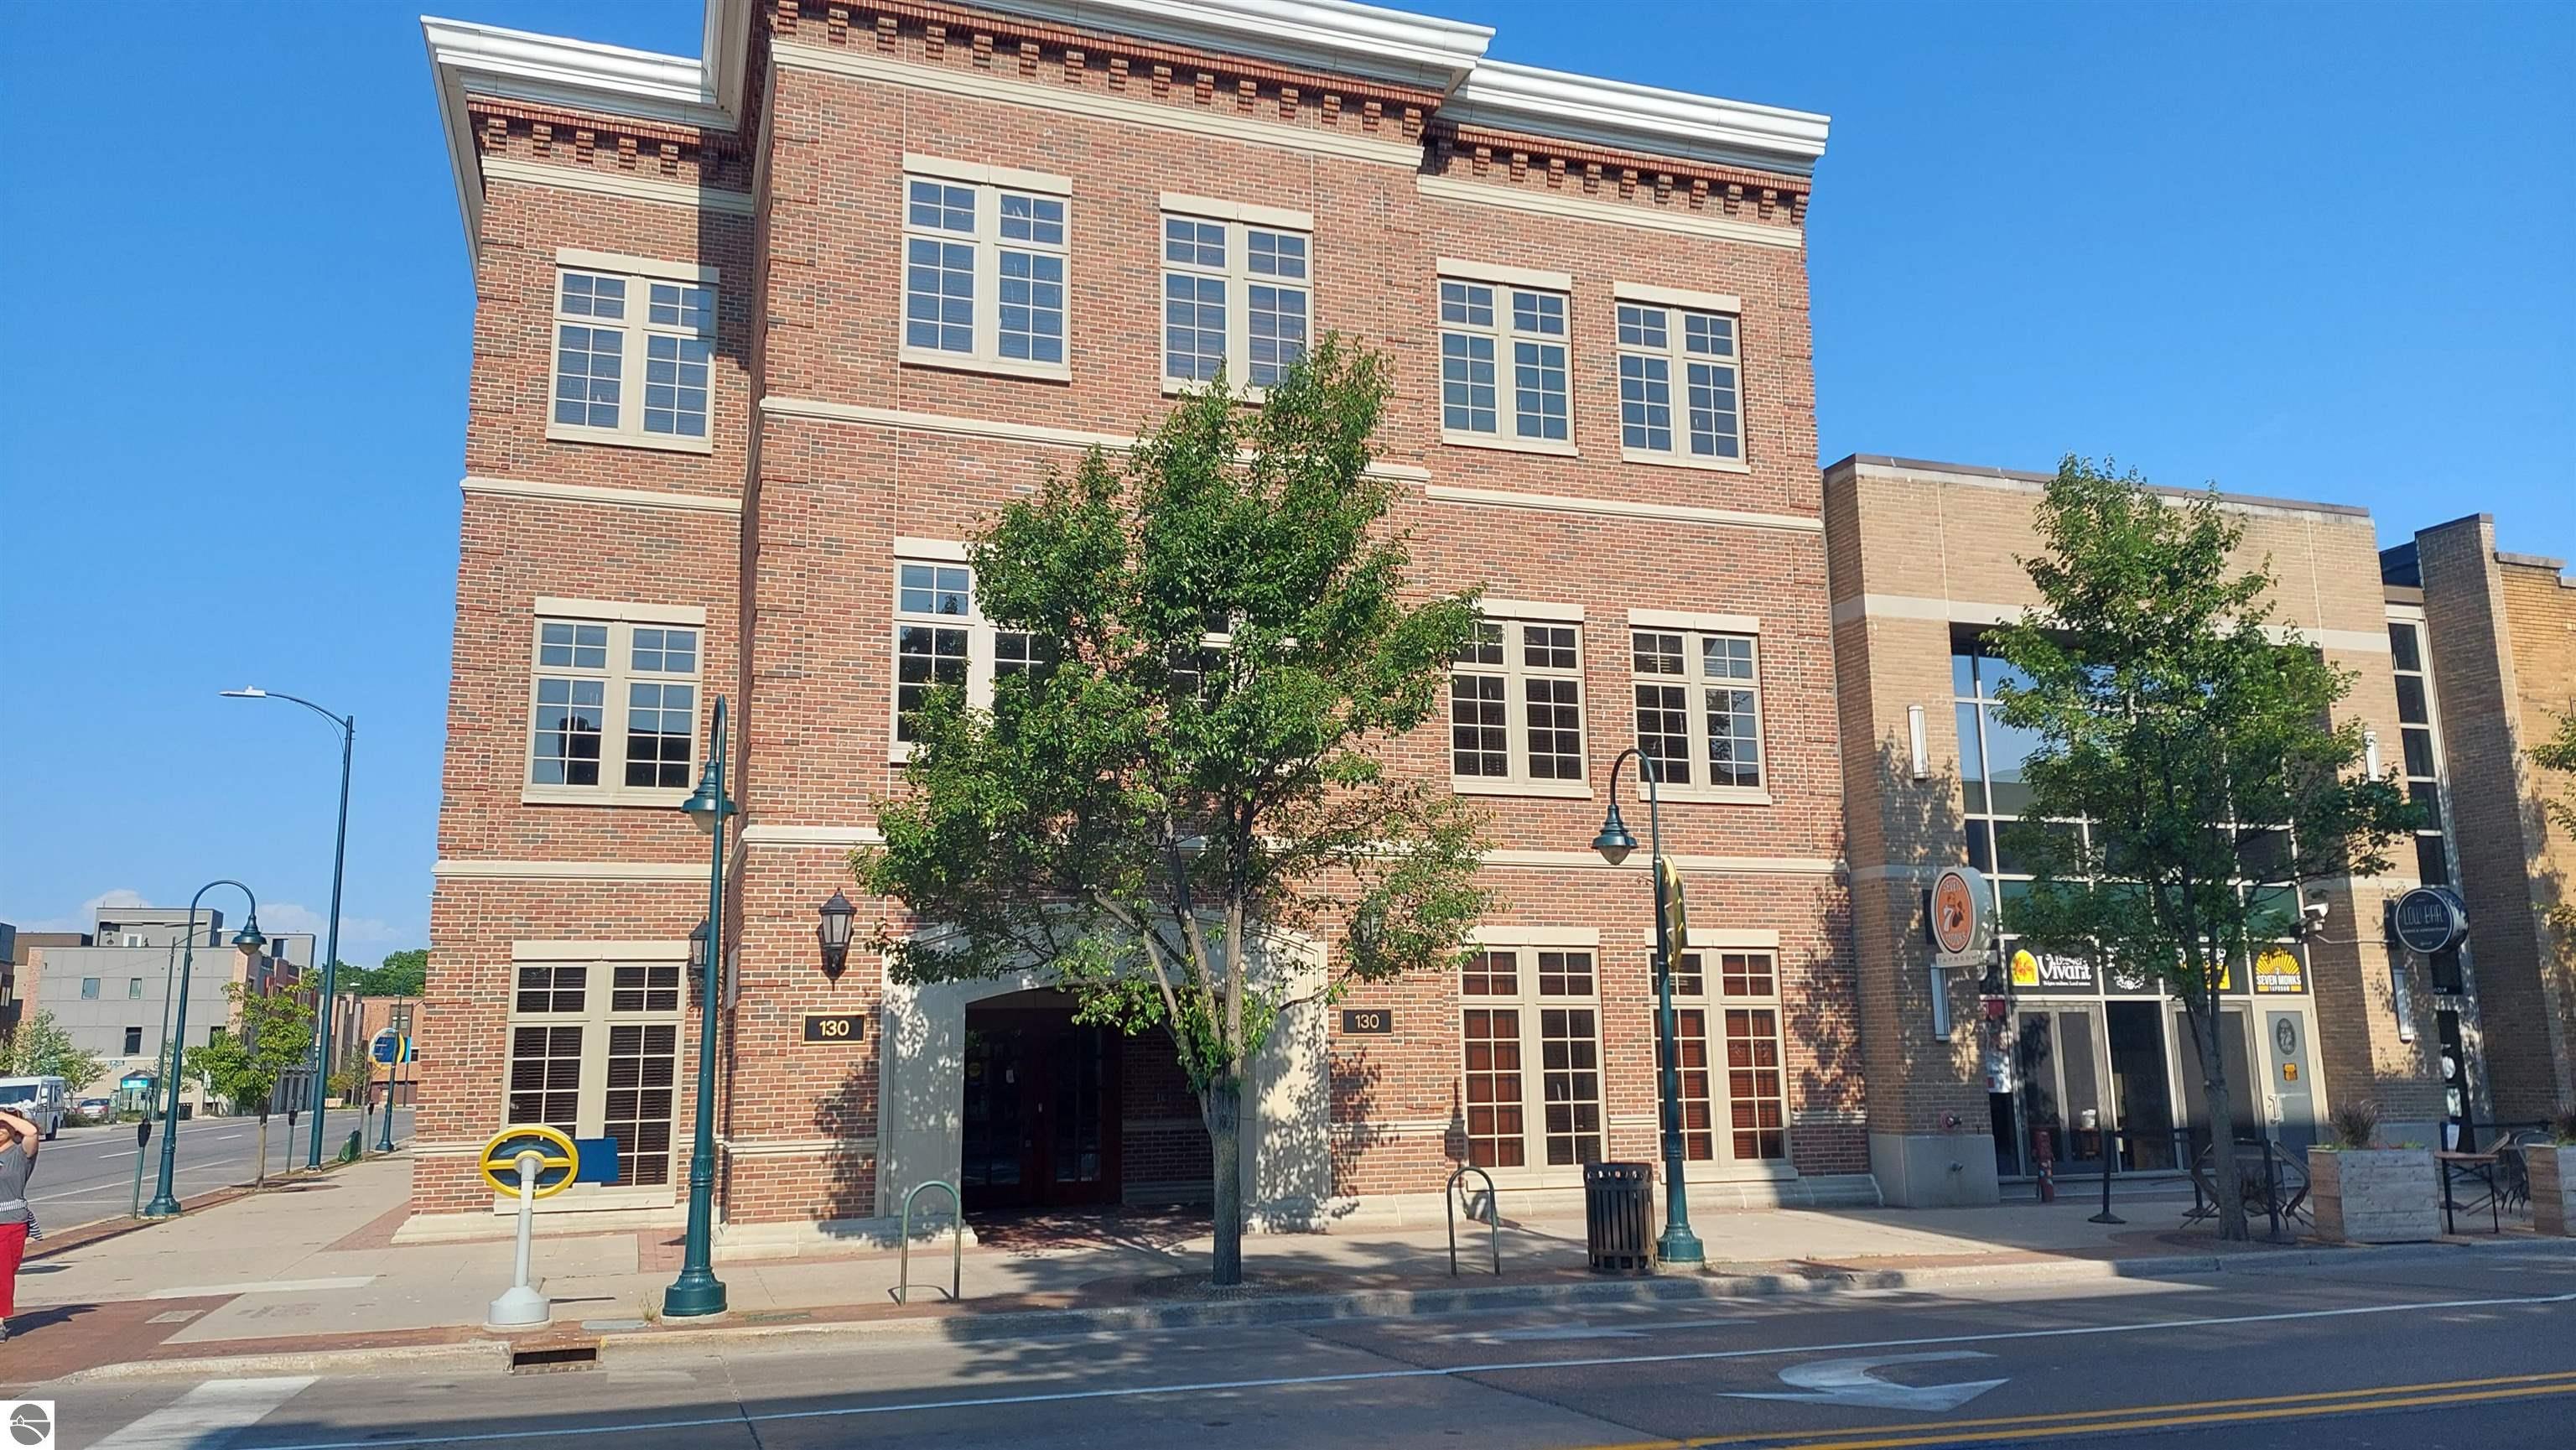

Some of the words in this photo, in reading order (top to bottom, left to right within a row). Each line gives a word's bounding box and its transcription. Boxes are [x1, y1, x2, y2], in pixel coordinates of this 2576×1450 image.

[2402, 906, 2423, 926] LOW
[2424, 905, 2444, 924] BAR
[2036, 954, 2092, 980] Vivant
[2256, 974, 2277, 985] SEVEN
[2277, 974, 2302, 985] MONKS
[819, 1020, 849, 1037] 130
[1355, 1014, 1379, 1029] 130
